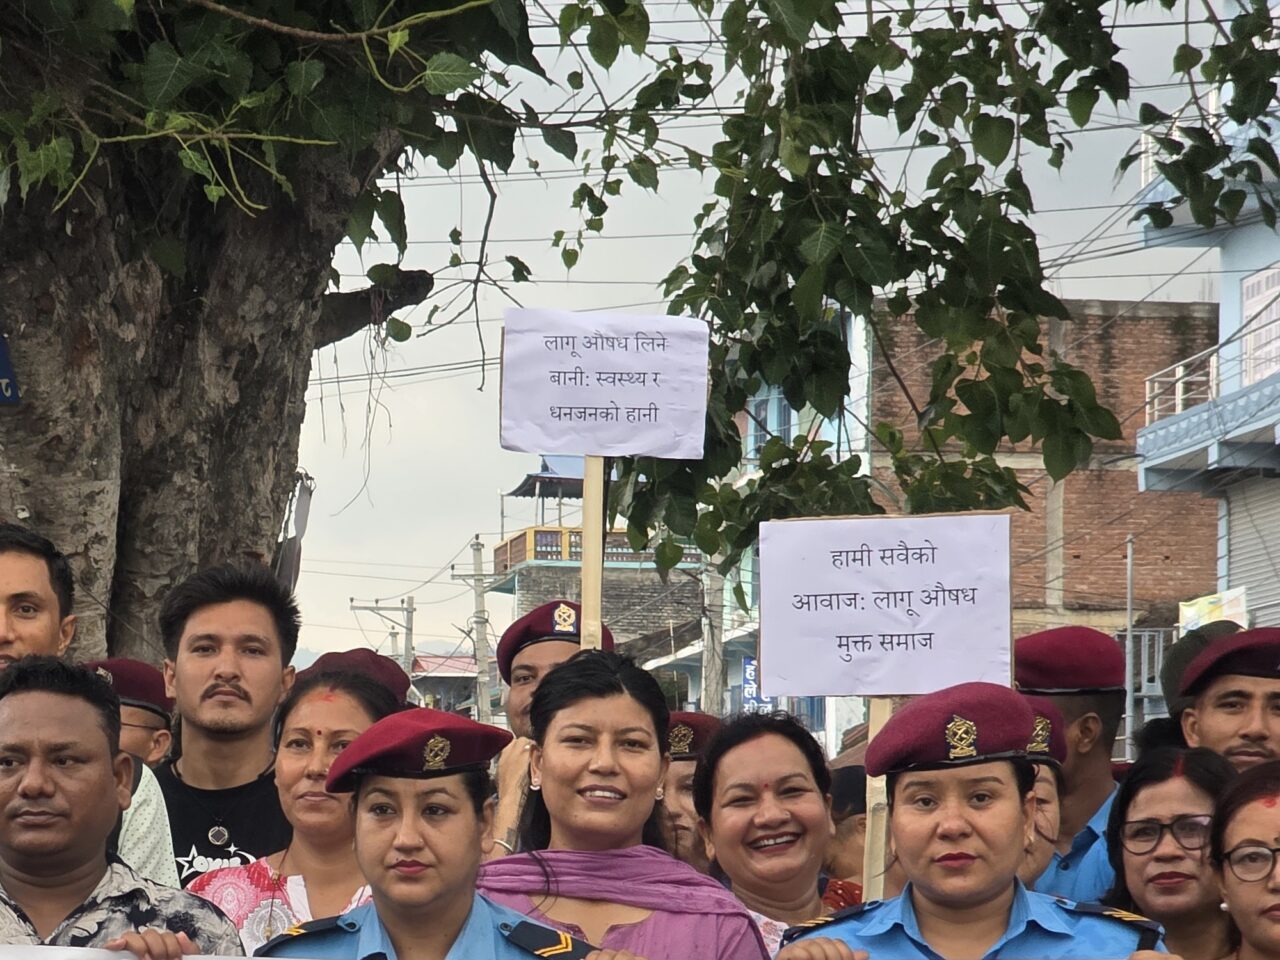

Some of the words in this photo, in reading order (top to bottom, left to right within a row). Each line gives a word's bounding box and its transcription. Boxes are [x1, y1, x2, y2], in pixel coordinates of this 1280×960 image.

[543, 335, 582, 358] लागू
[582, 329, 630, 352] औषध
[634, 331, 668, 353] लिने
[549, 366, 590, 387] बानी:
[595, 370, 648, 388] स्वस्थ्य
[651, 371, 662, 388] र
[549, 400, 621, 422] धनजनको
[625, 402, 661, 424] हानी
[830, 543, 873, 569] हामी
[791, 592, 866, 612] आवाज:
[872, 590, 920, 617] लागू
[920, 581, 979, 608] औषध
[836, 634, 873, 663] मुक्त
[878, 632, 935, 652] समाज
